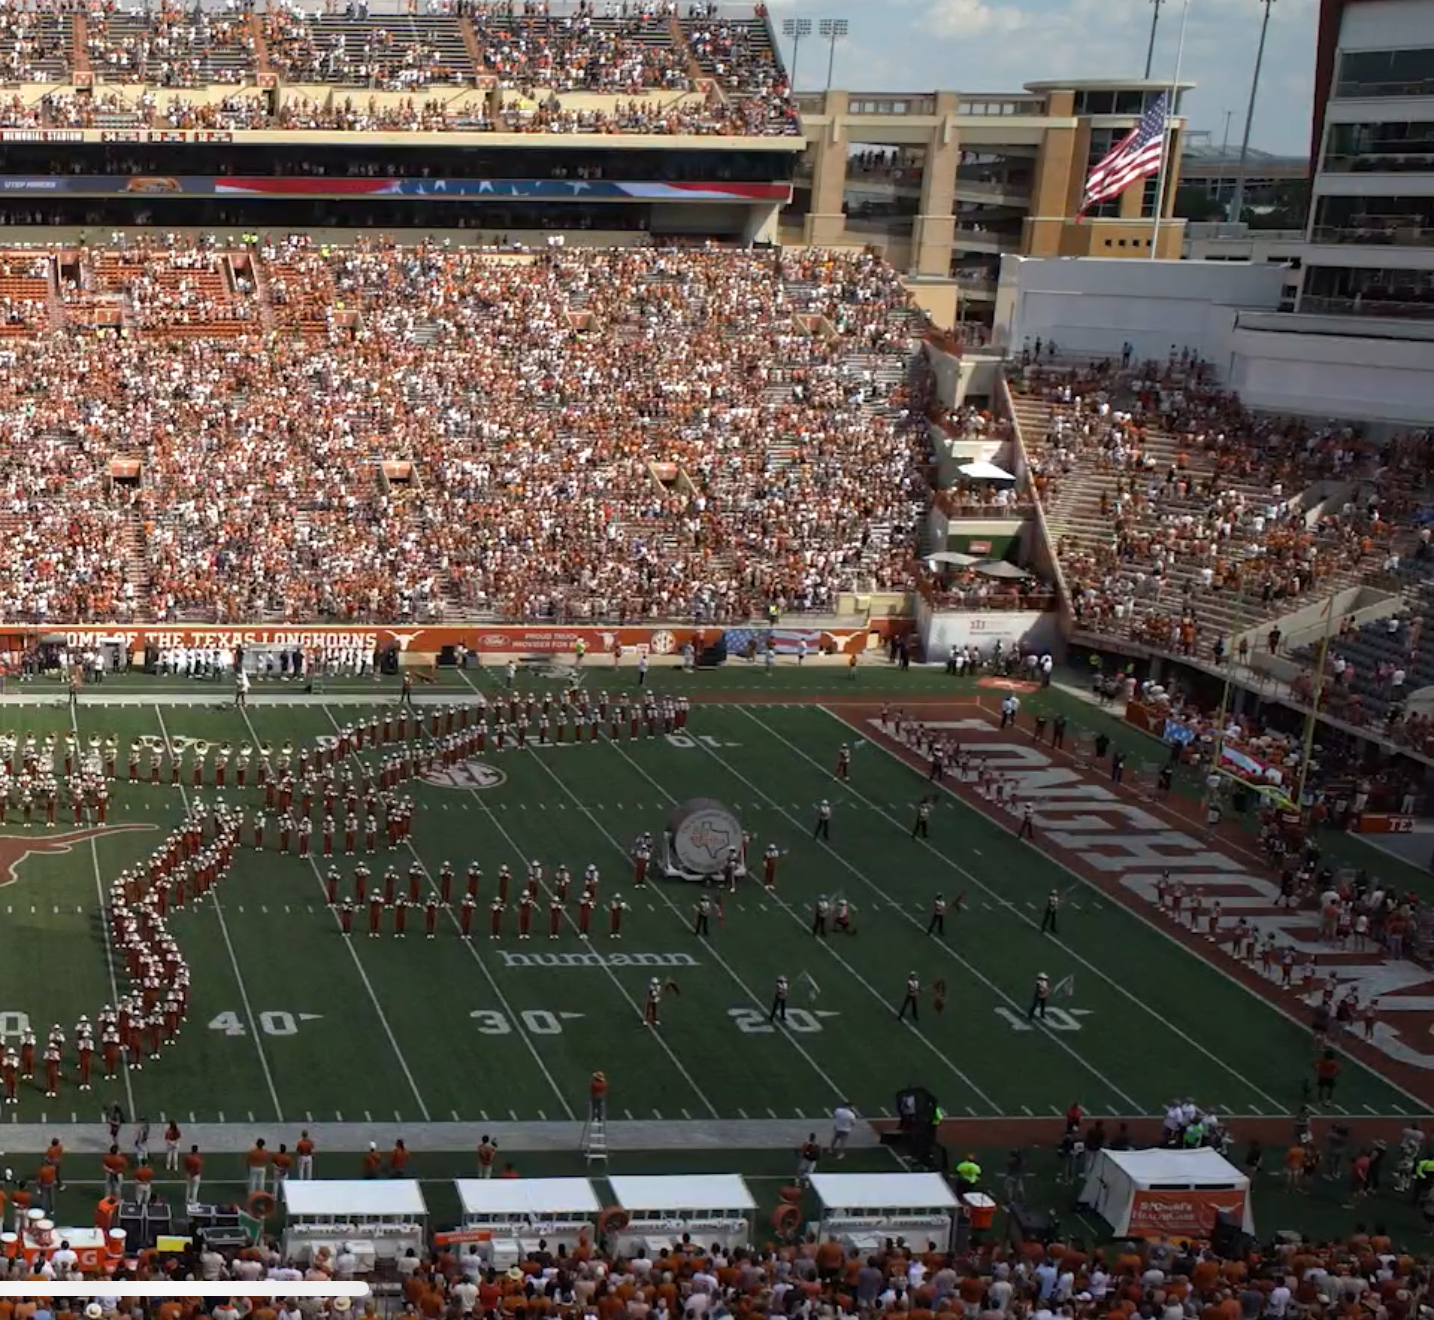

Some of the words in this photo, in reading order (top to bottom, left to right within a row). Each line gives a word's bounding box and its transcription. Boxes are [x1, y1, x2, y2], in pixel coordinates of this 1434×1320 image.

[2, 131, 43, 142] MEMORIAL
[47, 131, 83, 142] STADIUM
[4, 180, 25, 188] UTEP
[26, 180, 57, 188] MINERS
[145, 631, 184, 648] THE
[191, 631, 256, 648] TEXAS
[263, 631, 377, 648] LONGHORNS
[496, 950, 702, 966] humann
[208, 1011, 298, 1036] 40
[470, 1009, 562, 1035] 30
[727, 1008, 824, 1032] 20
[993, 1006, 1082, 1030] 10
[81, 1250, 97, 1266] G
